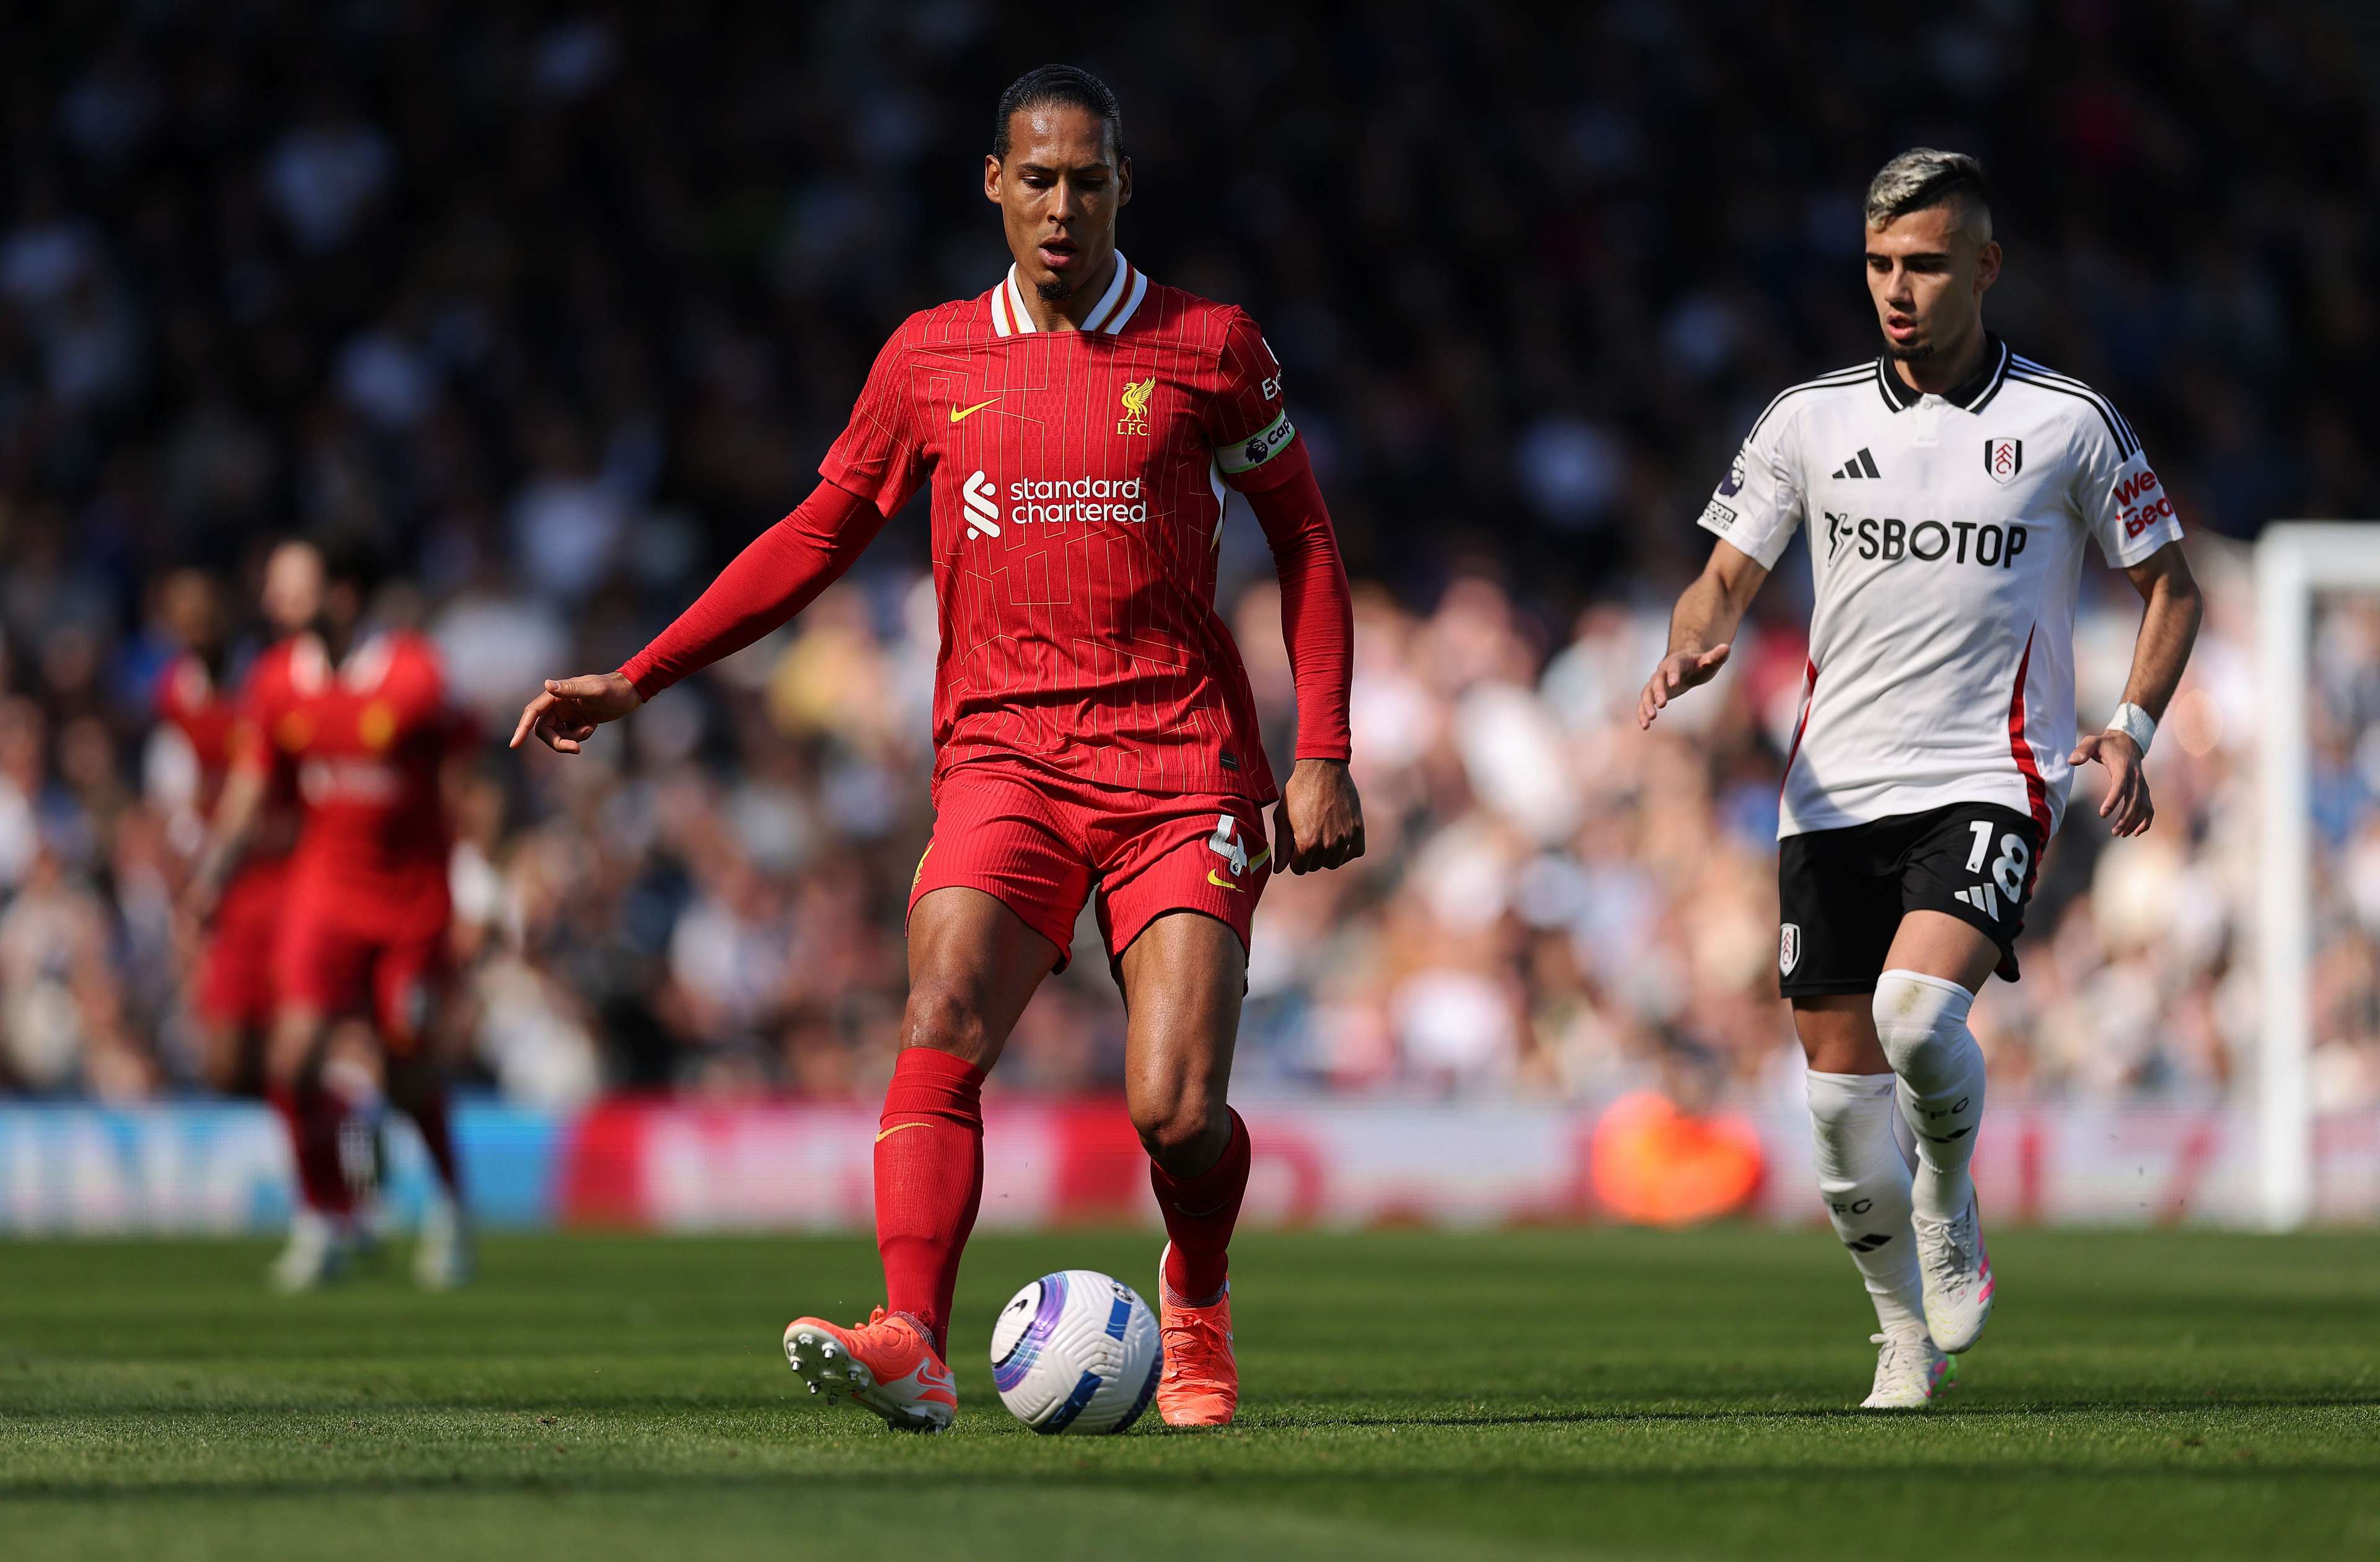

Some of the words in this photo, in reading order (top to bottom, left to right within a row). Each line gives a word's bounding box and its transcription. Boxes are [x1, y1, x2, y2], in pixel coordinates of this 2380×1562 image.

[1010, 475, 1141, 500] standard
[1011, 499, 1147, 524] chartered
[1858, 518, 2027, 568] SBOTOP
[1209, 814, 1247, 877] 4
[1965, 820, 2029, 904] 18
